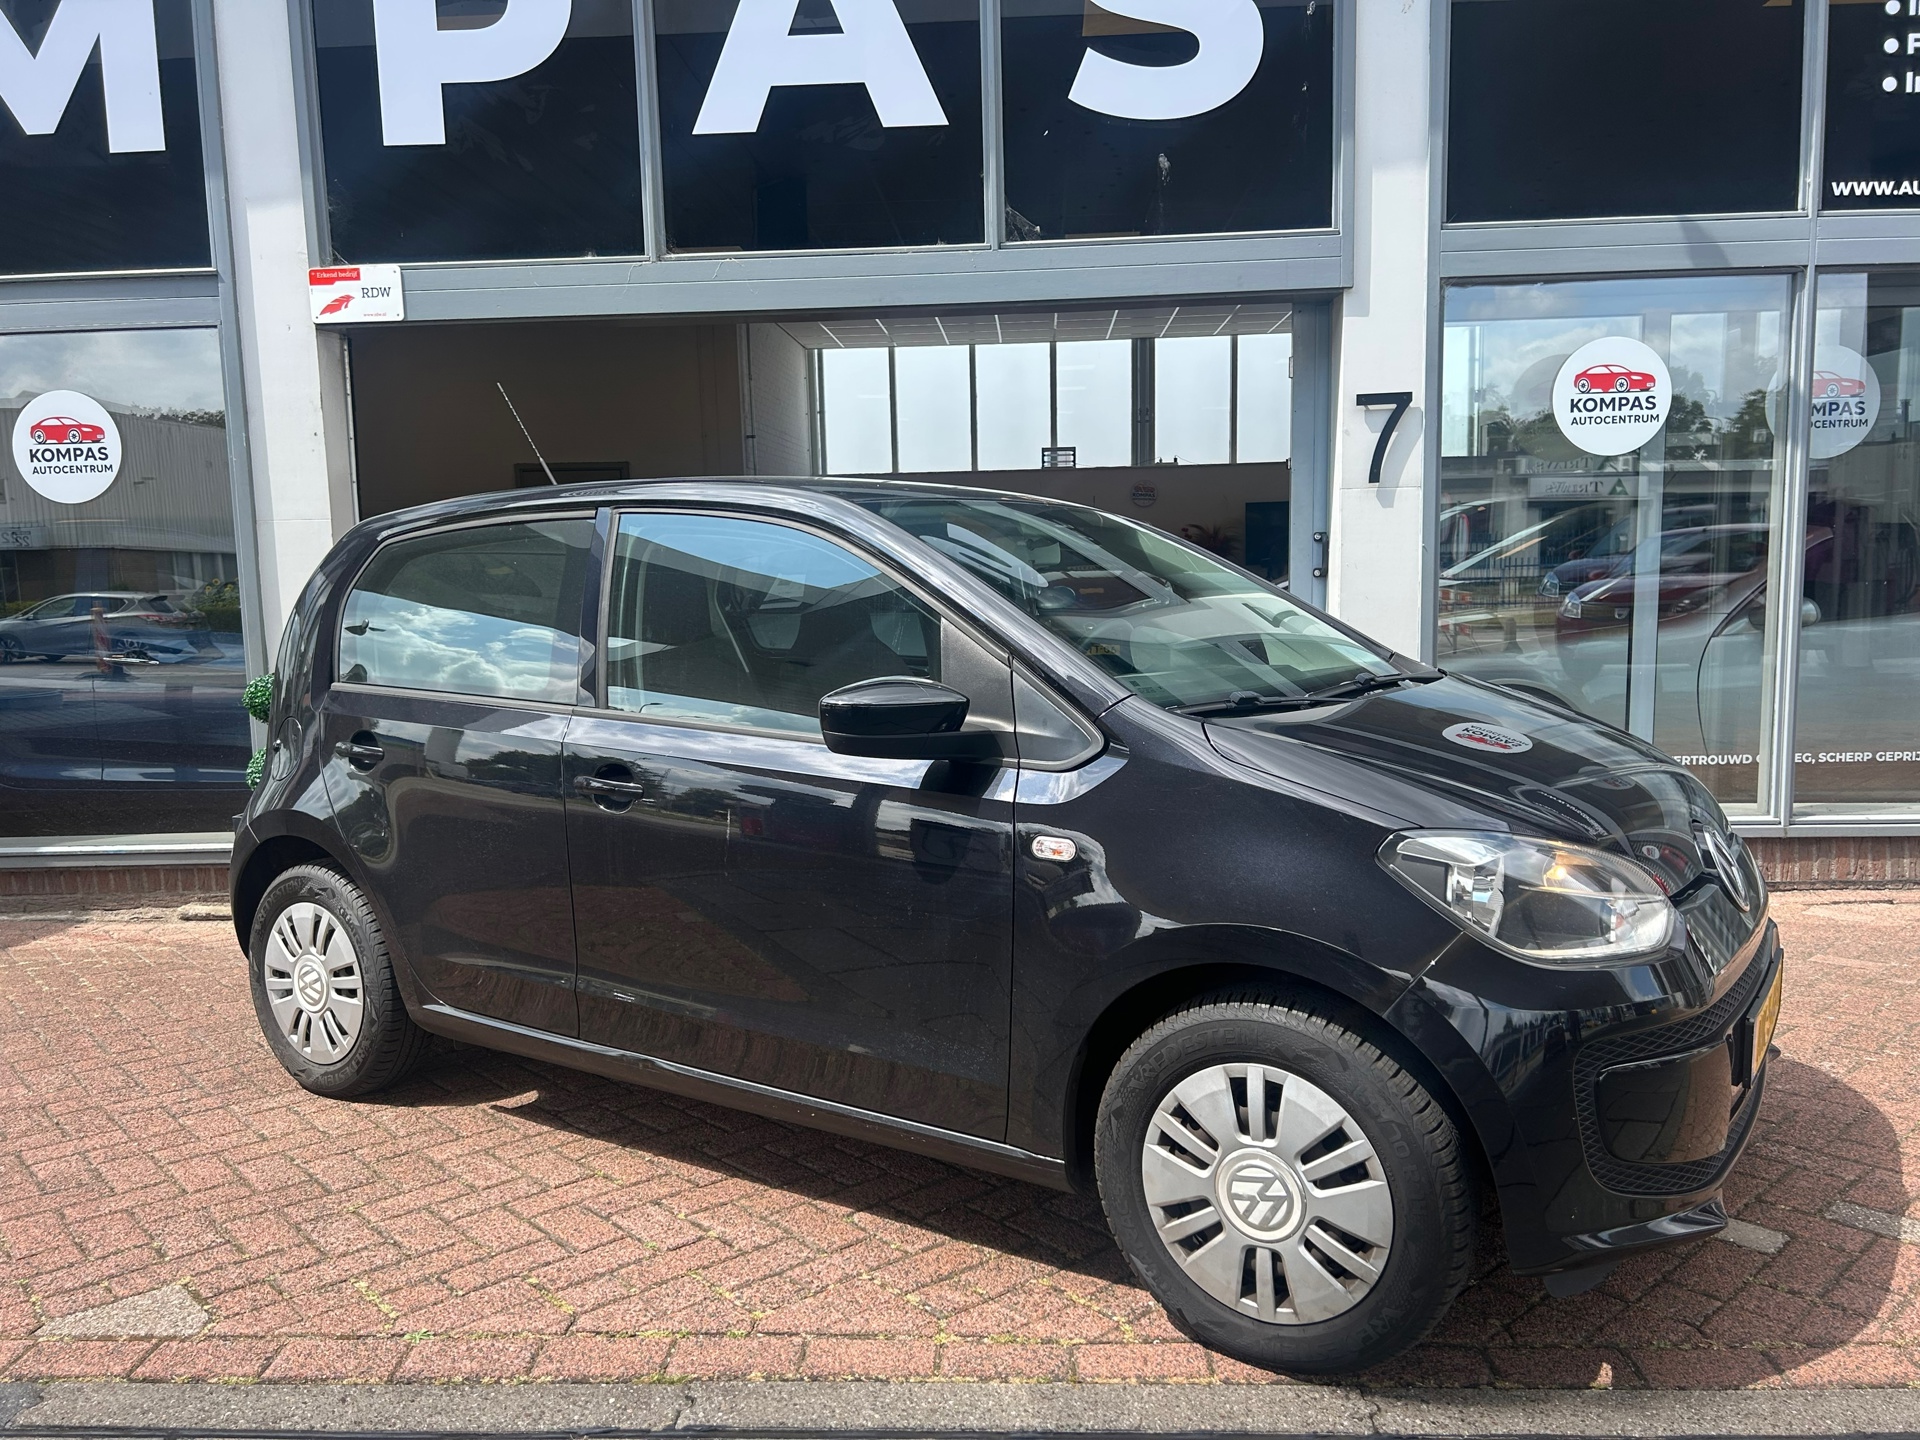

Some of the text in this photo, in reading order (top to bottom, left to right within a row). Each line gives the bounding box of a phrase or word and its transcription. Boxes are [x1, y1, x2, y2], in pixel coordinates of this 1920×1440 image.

[361, 286, 391, 298] RDW
[1570, 395, 1657, 413] KOMPAS
[1811, 400, 1866, 417] MPAS
[1570, 414, 1660, 426] AUTOCENTRUM
[1811, 418, 1868, 429] CENTRUM
[1356, 392, 1413, 483] 7
[29, 446, 109, 463] KOMPAS
[32, 464, 113, 475] AUTOCENTRUM
[1672, 754, 1752, 766] ERTROUWD
[1818, 752, 1873, 763] SCHERP
[1127, 1027, 1259, 1091] VREDESTEIN
